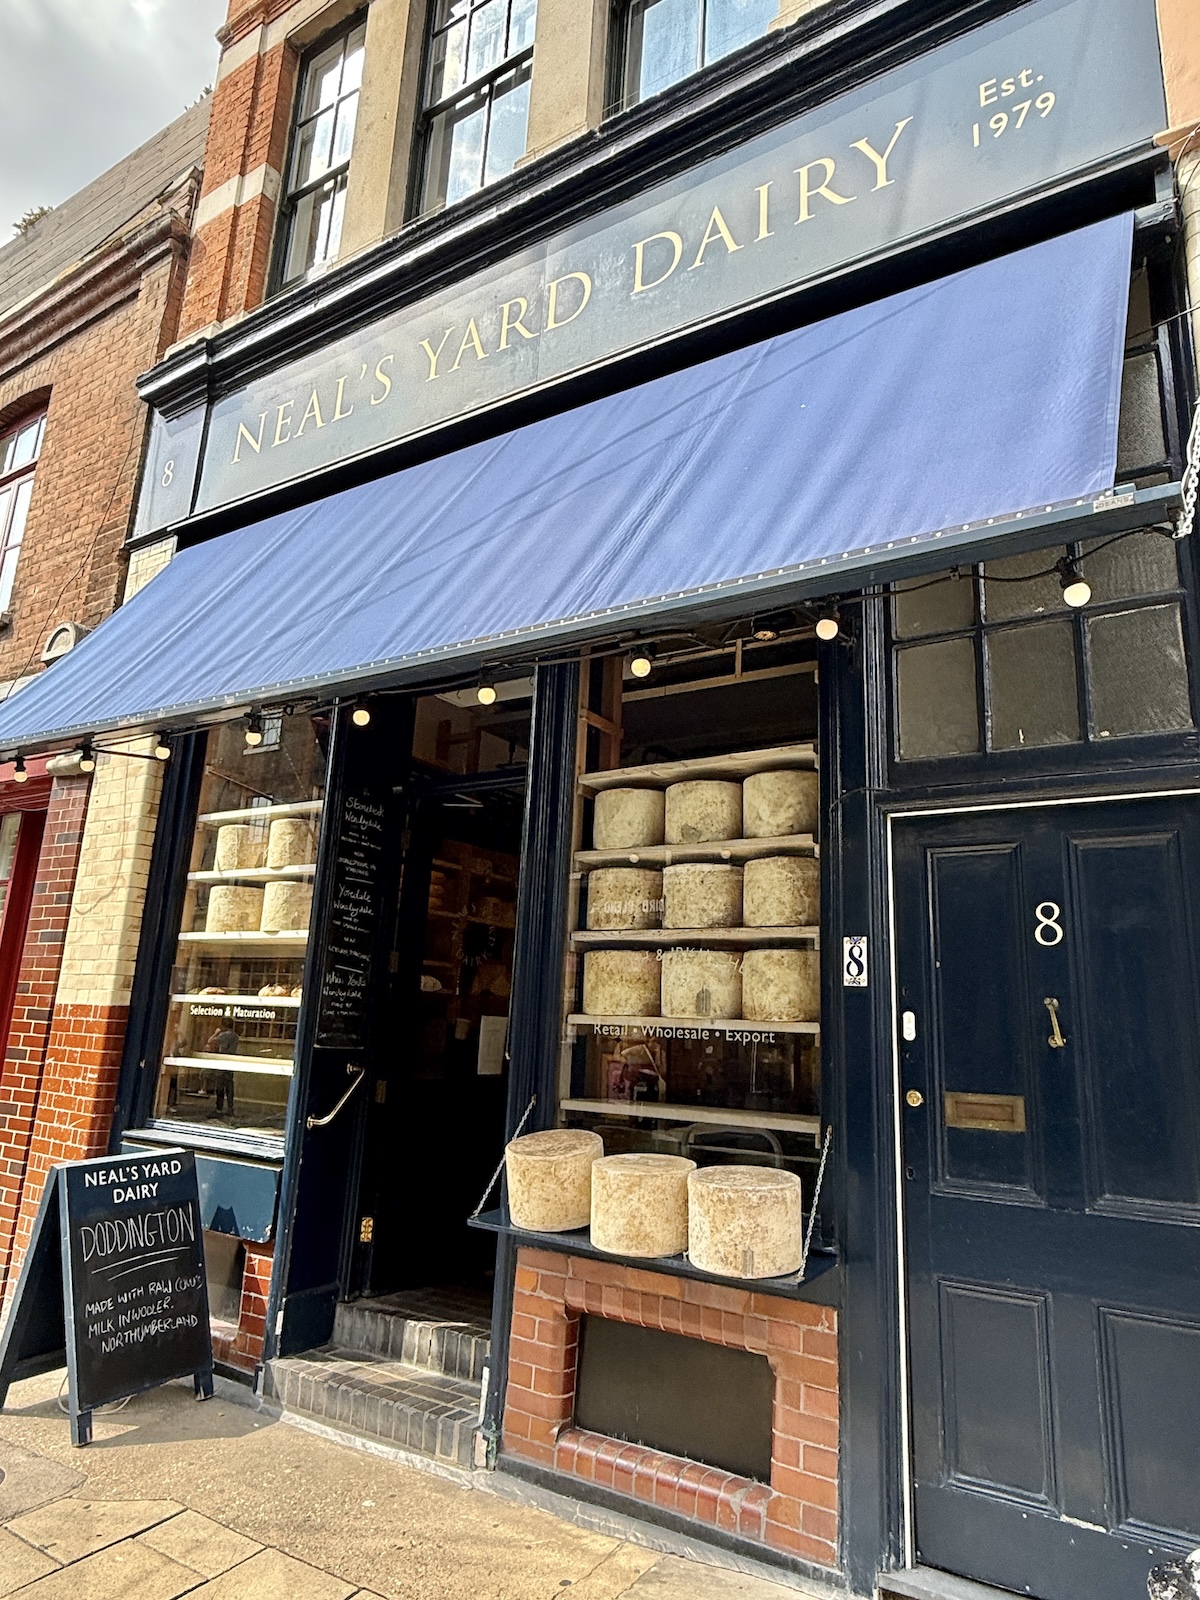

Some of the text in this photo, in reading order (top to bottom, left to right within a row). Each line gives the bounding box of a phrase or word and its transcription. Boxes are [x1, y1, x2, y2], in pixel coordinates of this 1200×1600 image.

[978, 67, 1044, 108] Est.
[971, 91, 1056, 148] 1979
[231, 115, 914, 465] NEAL'S YARD DAIRY
[161, 459, 175, 487] 8
[1034, 901, 1063, 946] 8
[845, 944, 865, 978] 8
[189, 1004, 276, 1019] Selection & Maturation
[593, 1023, 776, 1046] Retail Wholesale Export
[84, 1160, 182, 1188] NEAL'S YARD
[113, 1182, 159, 1204] DAIRY
[80, 1202, 195, 1262] DODDINGTON
[85, 1297, 115, 1319] MADE
[117, 1286, 145, 1304] WITH
[148, 1278, 172, 1295] RAW
[88, 1318, 116, 1339] MILK
[101, 1314, 199, 1354] NORTHUMBERLAND
